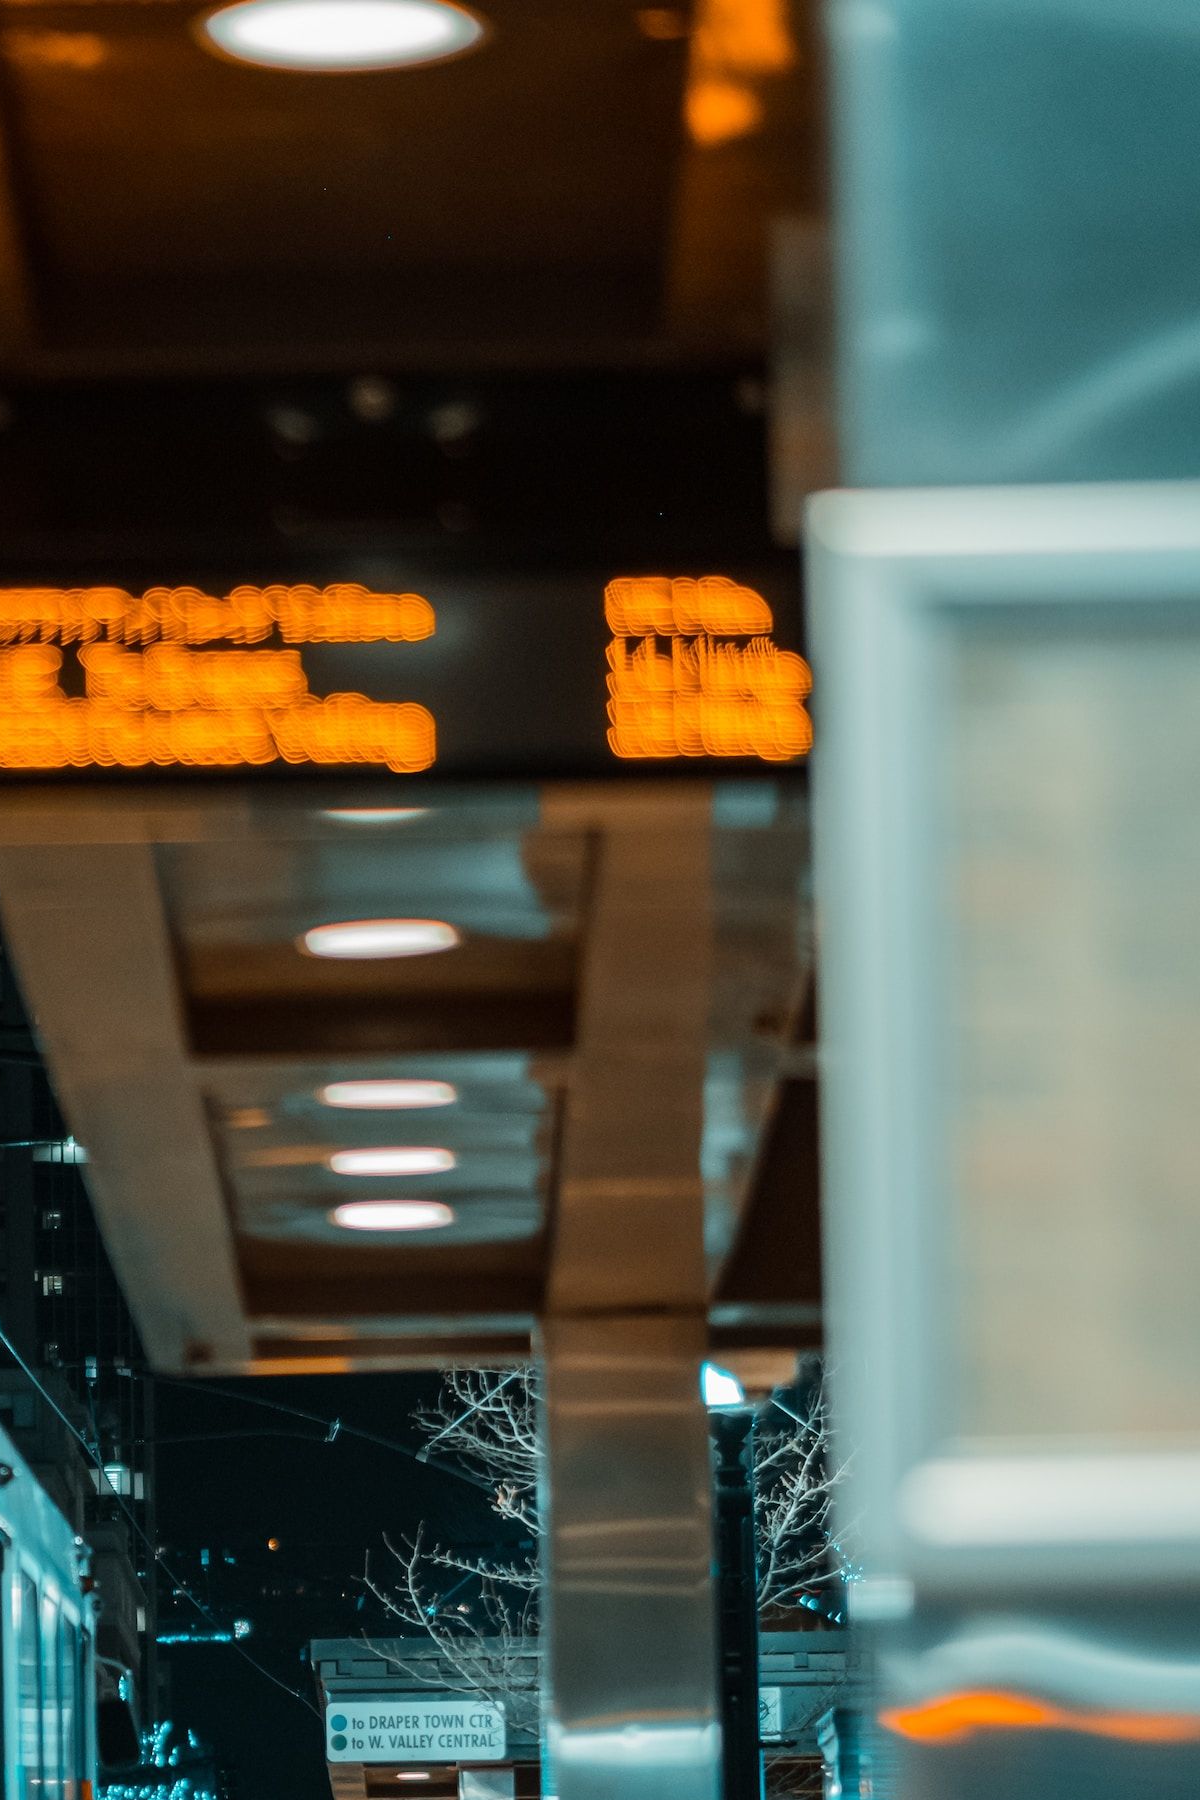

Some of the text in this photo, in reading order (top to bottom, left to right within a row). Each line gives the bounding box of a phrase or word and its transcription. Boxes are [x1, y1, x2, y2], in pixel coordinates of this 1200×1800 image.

[352, 1714, 493, 1730] to DRAPER TOWN CTR
[352, 1734, 496, 1749] to W. VALLEY CENTRAL
